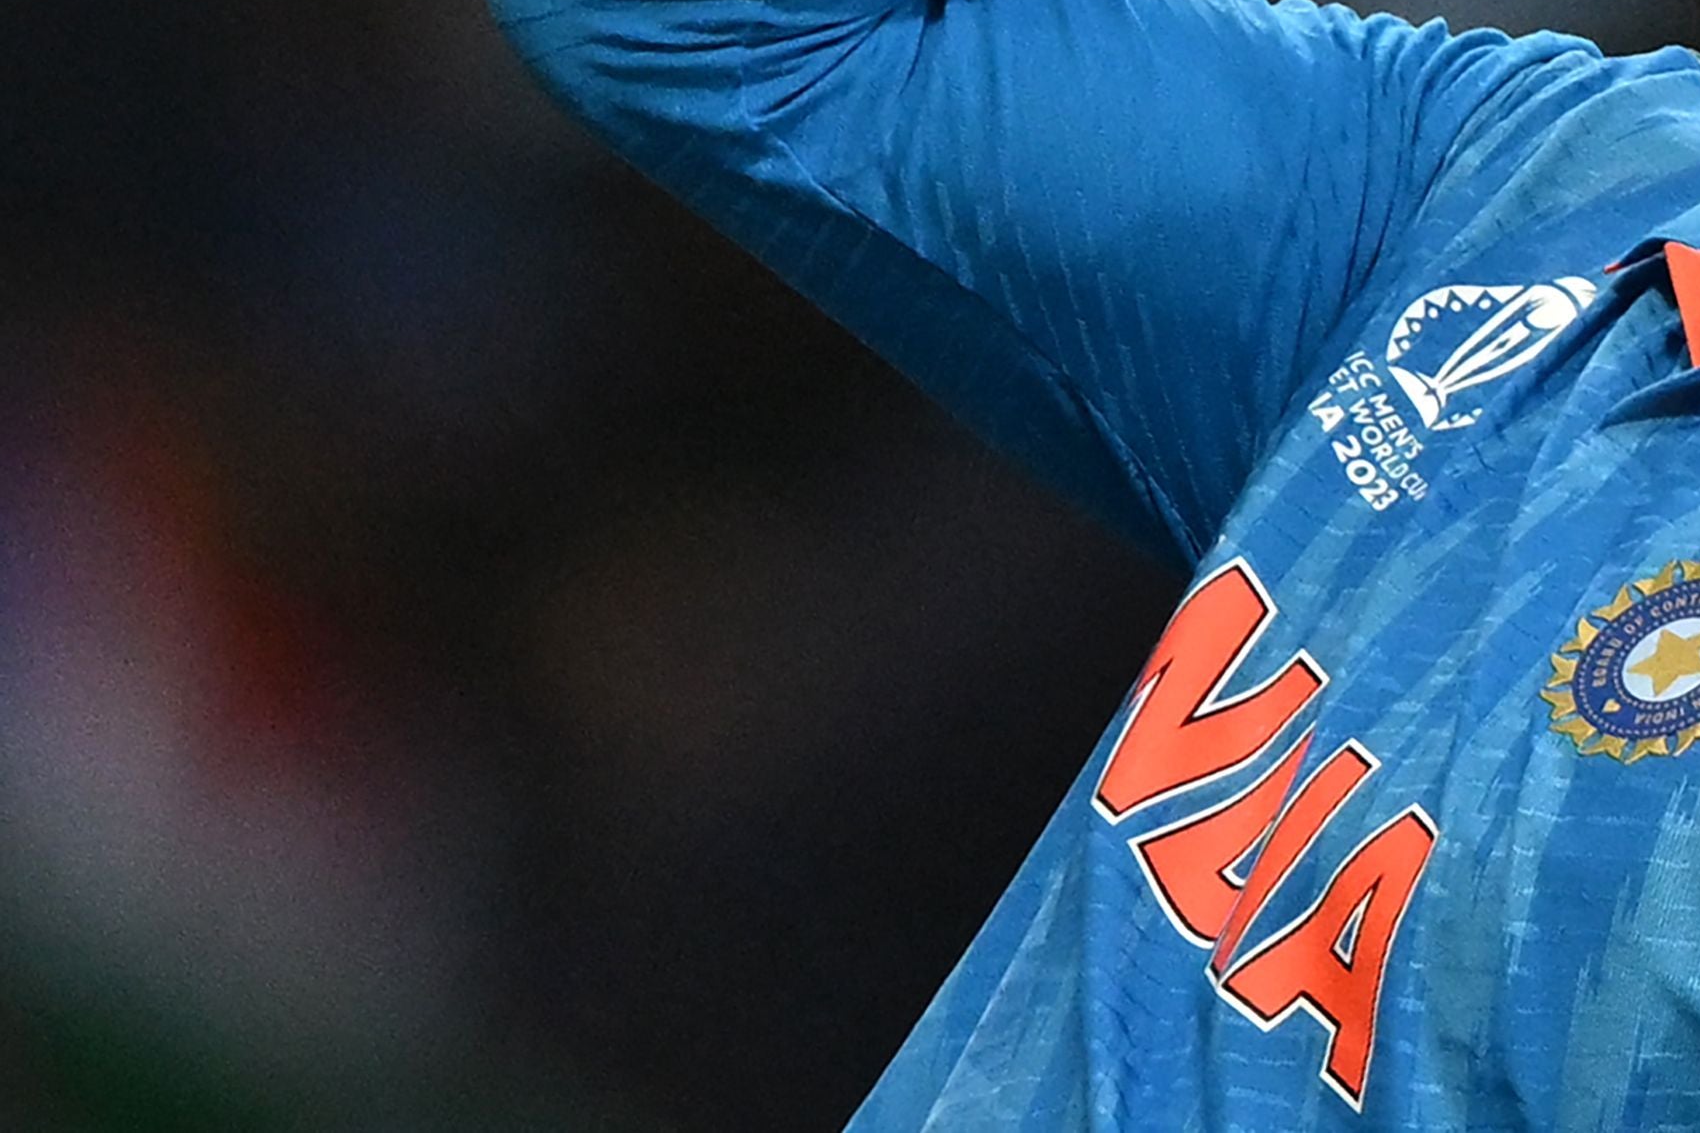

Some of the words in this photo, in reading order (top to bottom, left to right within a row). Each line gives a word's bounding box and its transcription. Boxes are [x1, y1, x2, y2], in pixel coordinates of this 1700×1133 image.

[1344, 350, 1382, 388] ICC
[1369, 393, 1425, 460] MEN'S
[1349, 398, 1409, 479] WORLD
[1331, 435, 1399, 511] 2023
